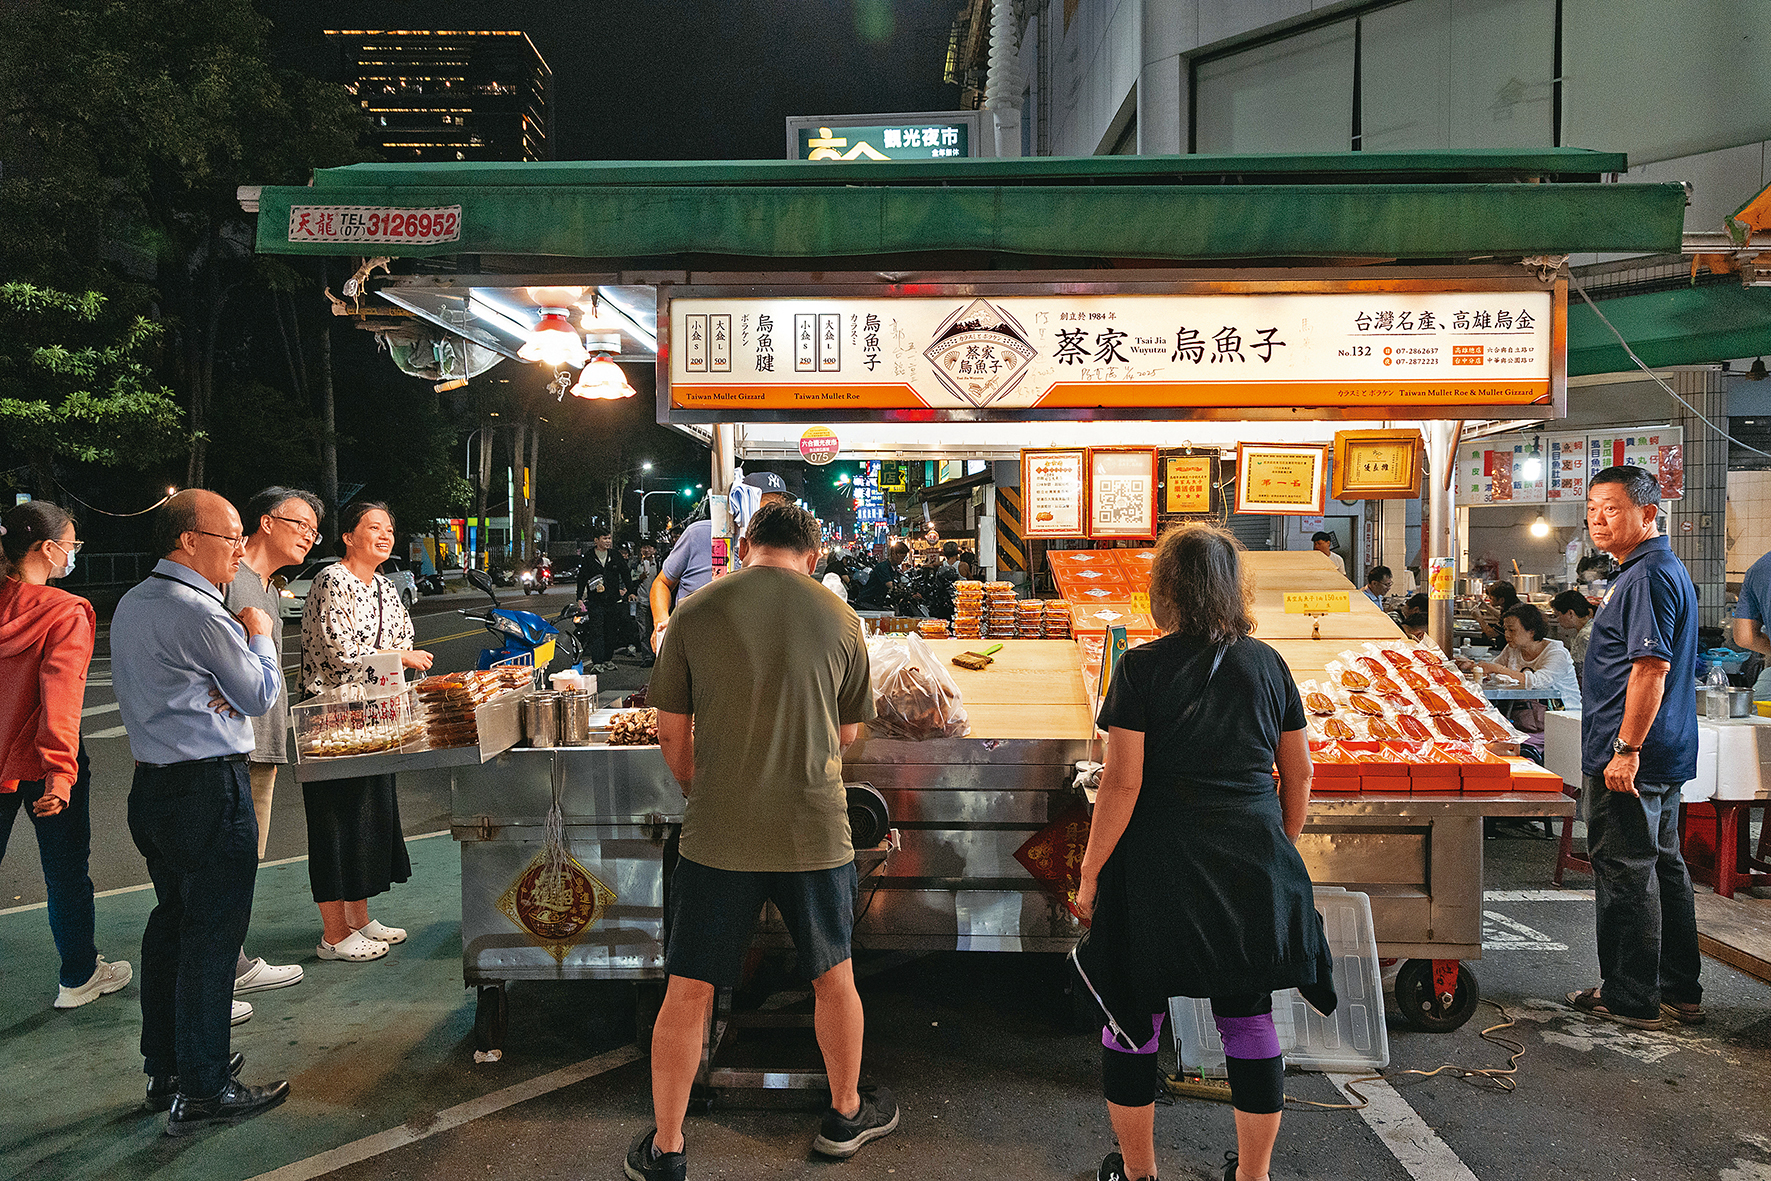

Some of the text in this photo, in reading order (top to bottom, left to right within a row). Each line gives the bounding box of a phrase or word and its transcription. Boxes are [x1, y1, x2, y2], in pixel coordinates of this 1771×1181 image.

[884, 128, 958, 148] 觀光夜市
[296, 212, 337, 236] 天龍
[340, 213, 366, 225] TEL
[366, 213, 457, 237] 3126952
[340, 226, 366, 236] (07)
[1060, 312, 1117, 321] 創立於 1984 年
[1354, 309, 1536, 331] 台灣名產、高雄烏金
[691, 320, 702, 341] 小盒
[715, 320, 726, 341] 大盒
[801, 320, 811, 341] 小盒
[850, 313, 858, 346] カラスミ
[863, 313, 882, 372] 烏魚子
[1053, 327, 1130, 365] 蔡家
[1130, 346, 1167, 355] Wuyutzu
[1134, 337, 1167, 345] Tsai Jia
[1171, 326, 1287, 364] 烏魚子
[1395, 347, 1439, 355] 07-2862637
[965, 345, 995, 360] 蔡家
[958, 359, 1003, 375] 烏魚子
[821, 392, 845, 400] Mullet
[811, 452, 829, 462] 075
[1603, 439, 1612, 469] 苦瓜排
[1638, 436, 1647, 465] 魚丸
[1573, 486, 1583, 496] 50
